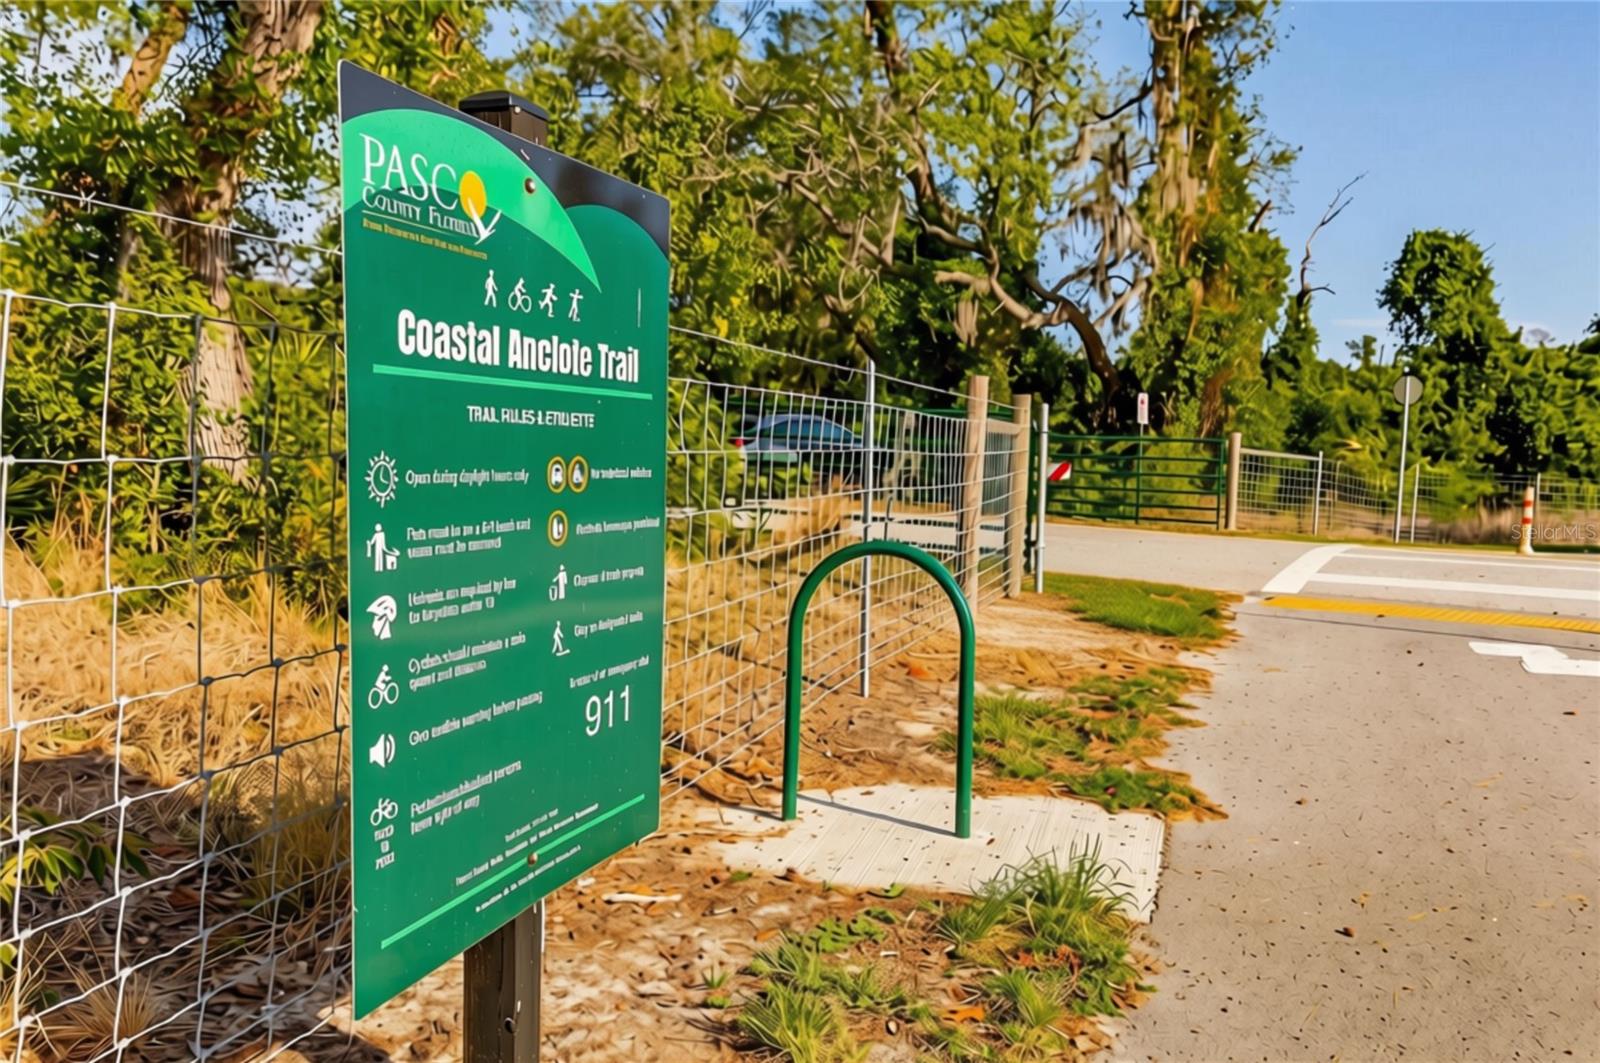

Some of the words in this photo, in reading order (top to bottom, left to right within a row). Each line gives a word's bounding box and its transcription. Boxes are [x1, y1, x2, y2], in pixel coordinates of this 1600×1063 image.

[397, 308, 500, 366] Coastal
[597, 343, 639, 383] Trail
[585, 684, 630, 737] 911
